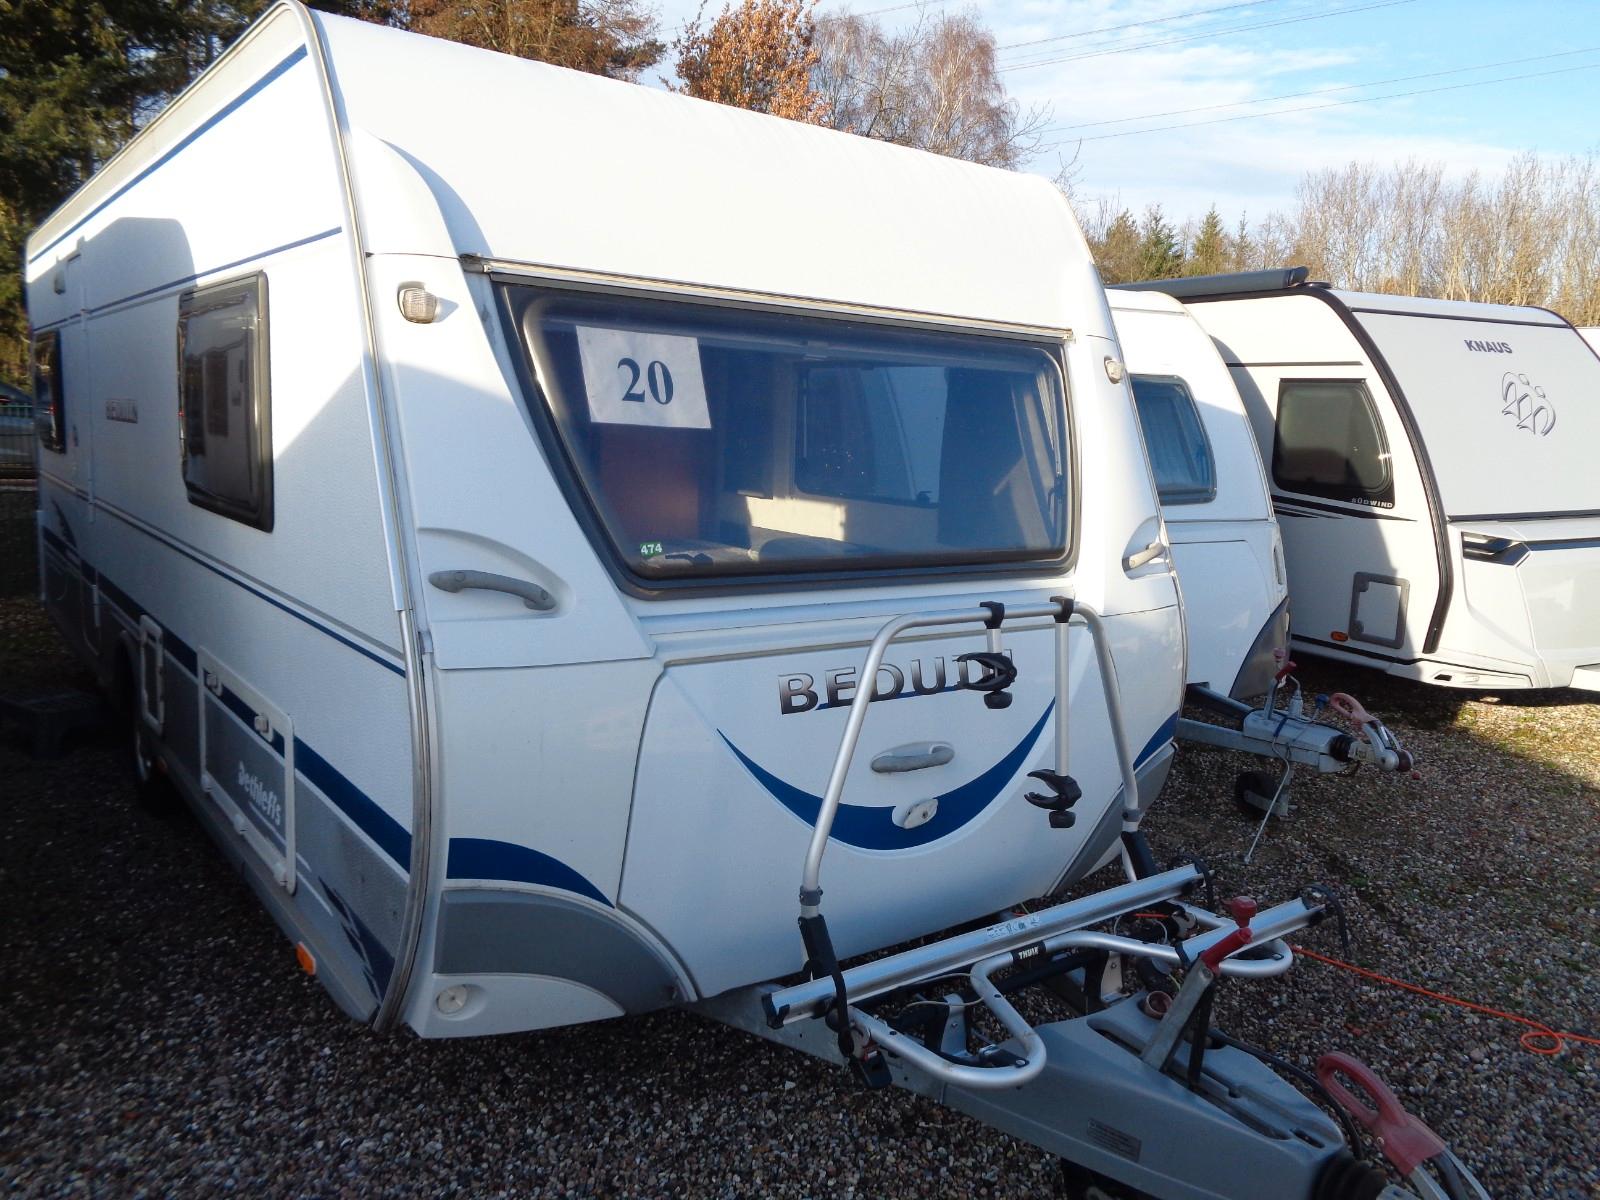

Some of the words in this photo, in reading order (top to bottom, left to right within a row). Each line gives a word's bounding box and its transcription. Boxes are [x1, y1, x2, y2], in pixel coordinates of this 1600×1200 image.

[1463, 339, 1513, 354] KNAUS
[617, 357, 674, 405] 20
[640, 543, 663, 555] 474
